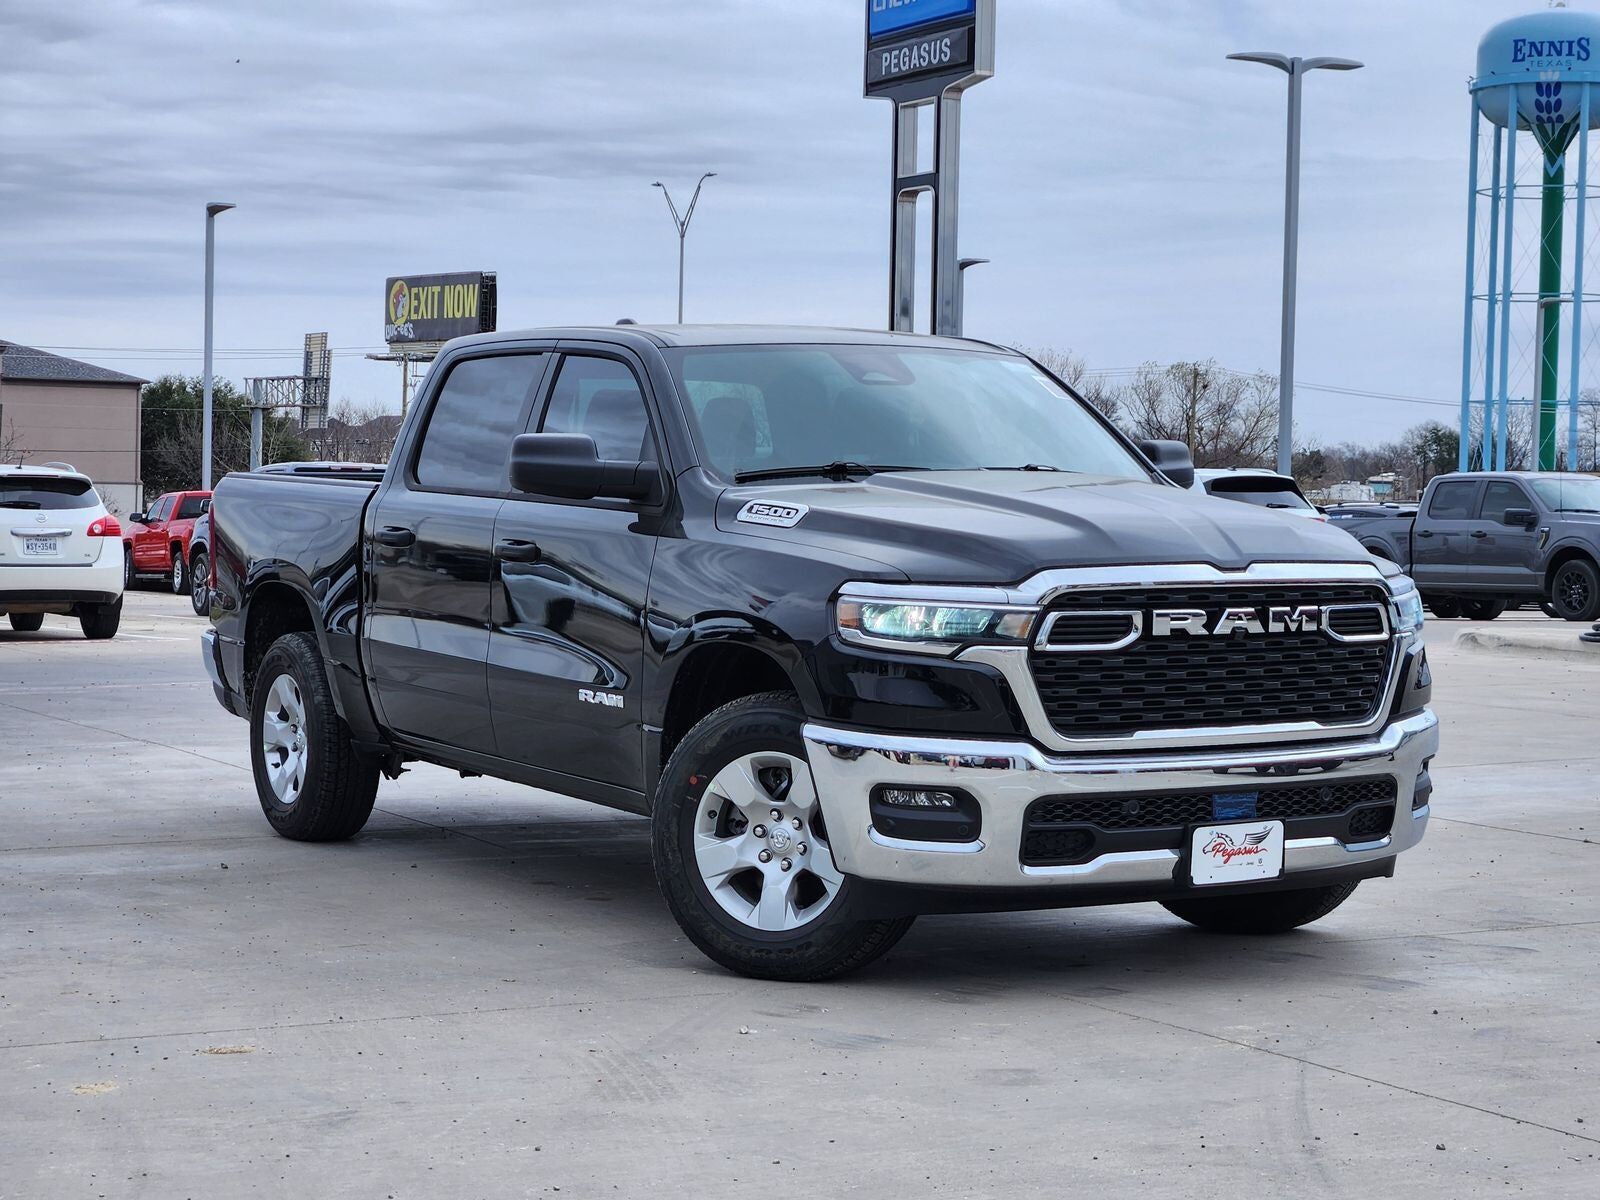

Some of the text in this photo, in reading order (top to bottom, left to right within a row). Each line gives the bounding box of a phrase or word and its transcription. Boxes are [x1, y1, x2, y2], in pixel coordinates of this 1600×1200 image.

[882, 38, 951, 75] PEGASUS
[1512, 37, 1590, 62] ENNIS
[1530, 60, 1572, 68] TEXAS
[410, 284, 479, 320] EXIT NOW
[751, 505, 799, 518] 1500
[1152, 605, 1318, 636] RAM
[578, 688, 624, 709] RAM
[1212, 842, 1268, 864] Pegasus
